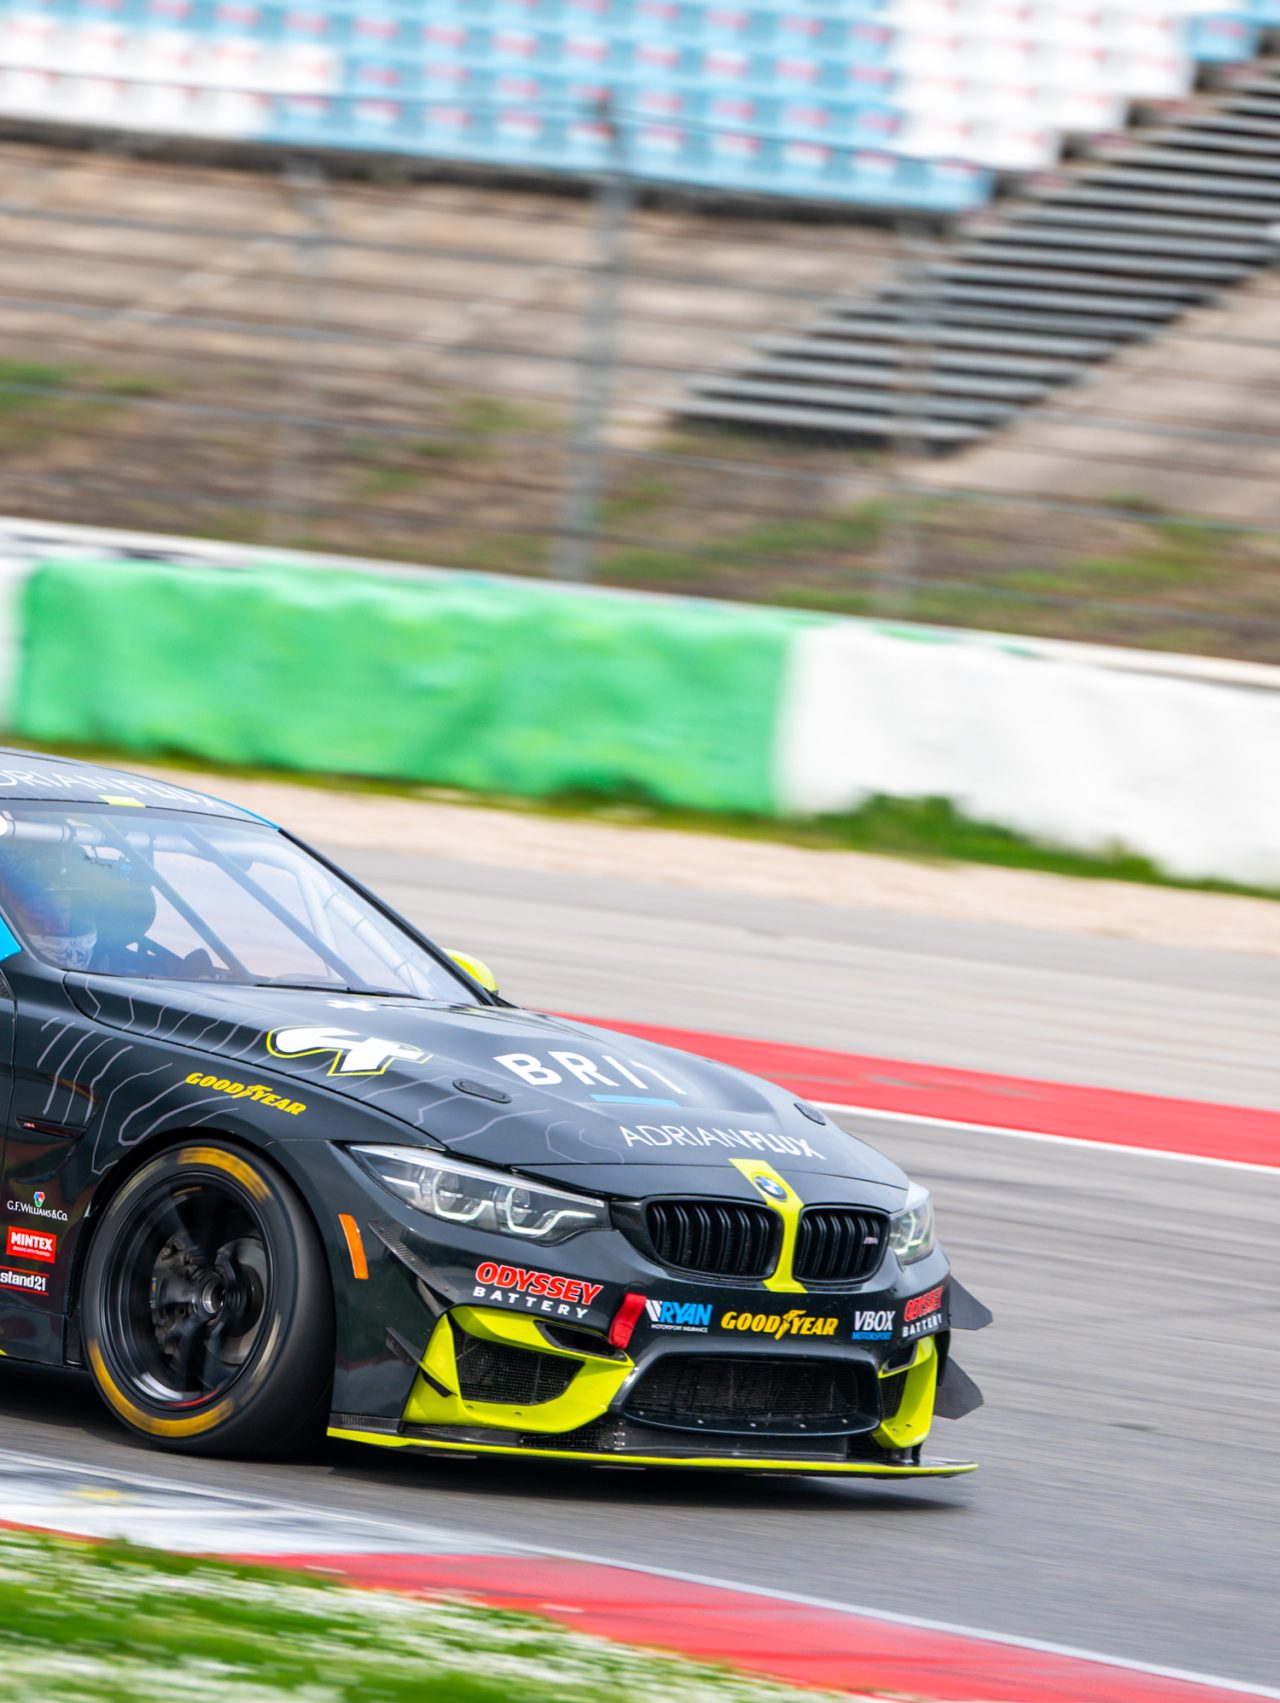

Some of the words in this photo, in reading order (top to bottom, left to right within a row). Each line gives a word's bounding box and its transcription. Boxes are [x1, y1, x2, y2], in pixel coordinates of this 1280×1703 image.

[184, 1072, 307, 1116] GOODYEAR
[10, 1231, 53, 1252] MINTEX
[0, 1270, 47, 1292] stand21
[475, 1261, 604, 1306] ODYSSEY
[472, 1286, 589, 1320] BATTERY
[659, 1300, 714, 1327] RYAN
[720, 1309, 839, 1341] GOODYEAR
[853, 1310, 896, 1332] VBOX
[901, 1313, 943, 1338] BATTERY
[851, 1331, 894, 1342] MOTORSPORT
